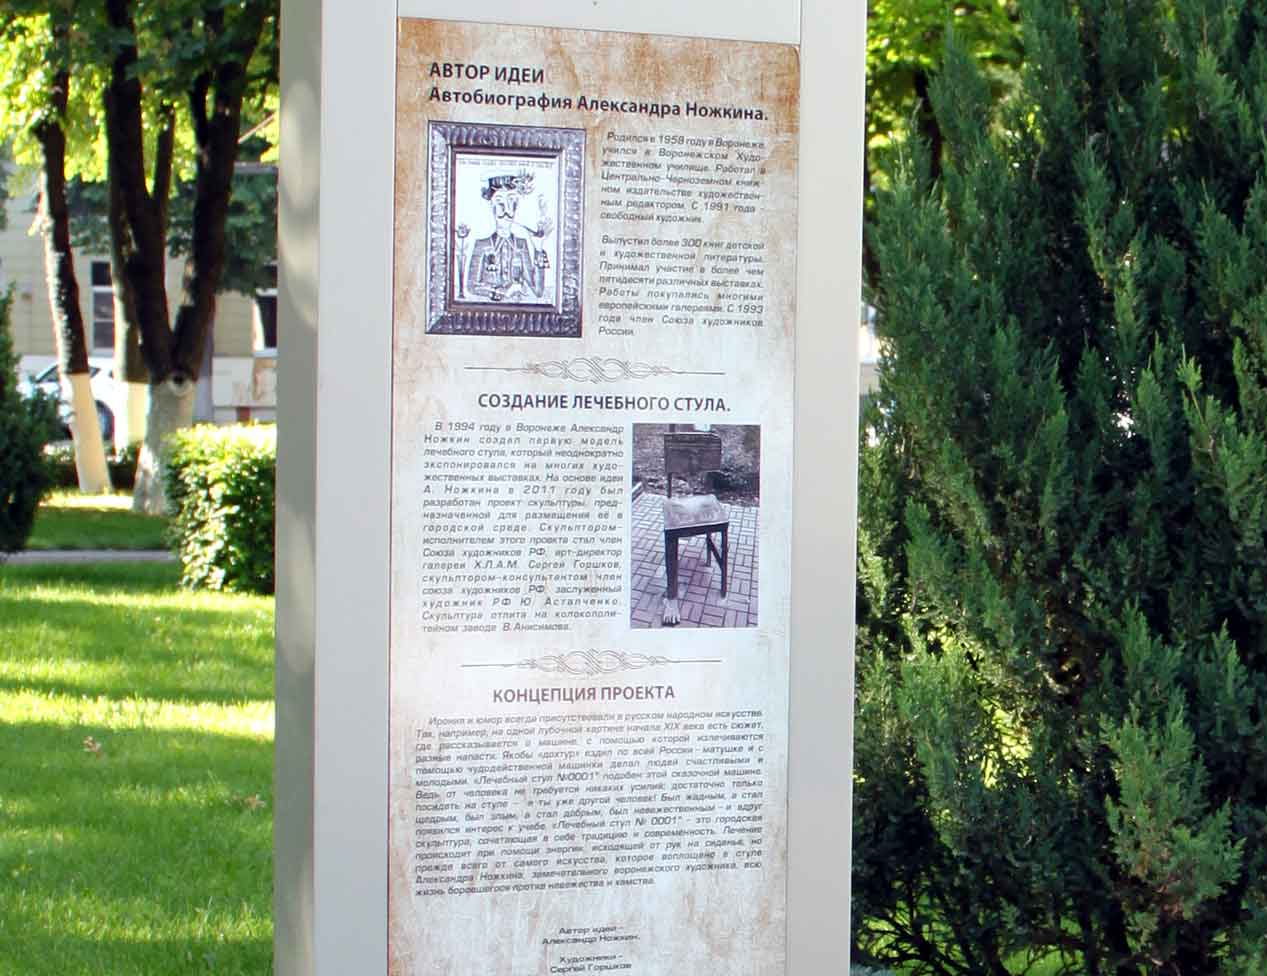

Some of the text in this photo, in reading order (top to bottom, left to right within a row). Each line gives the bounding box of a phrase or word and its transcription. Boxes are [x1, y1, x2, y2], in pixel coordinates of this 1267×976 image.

[431, 62, 544, 86] АВТОР ИДЕИ
[430, 87, 768, 122] Автобиография Александра Ножкина.
[608, 132, 706, 148] Родился 1958 году
[659, 147, 728, 160] Воронежском
[715, 163, 755, 173] Работал
[602, 234, 649, 246] Выпустил
[651, 236, 679, 246] более
[682, 237, 701, 247] 300
[600, 261, 649, 273] Принимал
[711, 265, 739, 274] более
[599, 286, 639, 296] Работы
[718, 292, 763, 300] многими
[738, 303, 763, 313] 1993
[662, 314, 693, 324] Союза
[478, 394, 568, 411] СОЗДАНИЕ
[572, 395, 669, 410] ЛЕЧЕБНОГО
[479, 424, 501, 433] году
[516, 423, 566, 434] Воронеже
[570, 424, 624, 435] Александр
[424, 435, 470, 443] Ножкин
[581, 438, 623, 447] модель
[424, 447, 623, 460] лечебного который неоднократно
[445, 485, 623, 496] Ножкина 2011 году был
[423, 498, 480, 508] разработан
[487, 500, 521, 509] проект
[498, 512, 517, 521] для
[423, 523, 484, 534] городской
[528, 560, 565, 571] Сергей
[493, 685, 675, 704] КОНЦЕПЦИЯ ПРОЕКТА
[550, 964, 585, 974] Сергей
